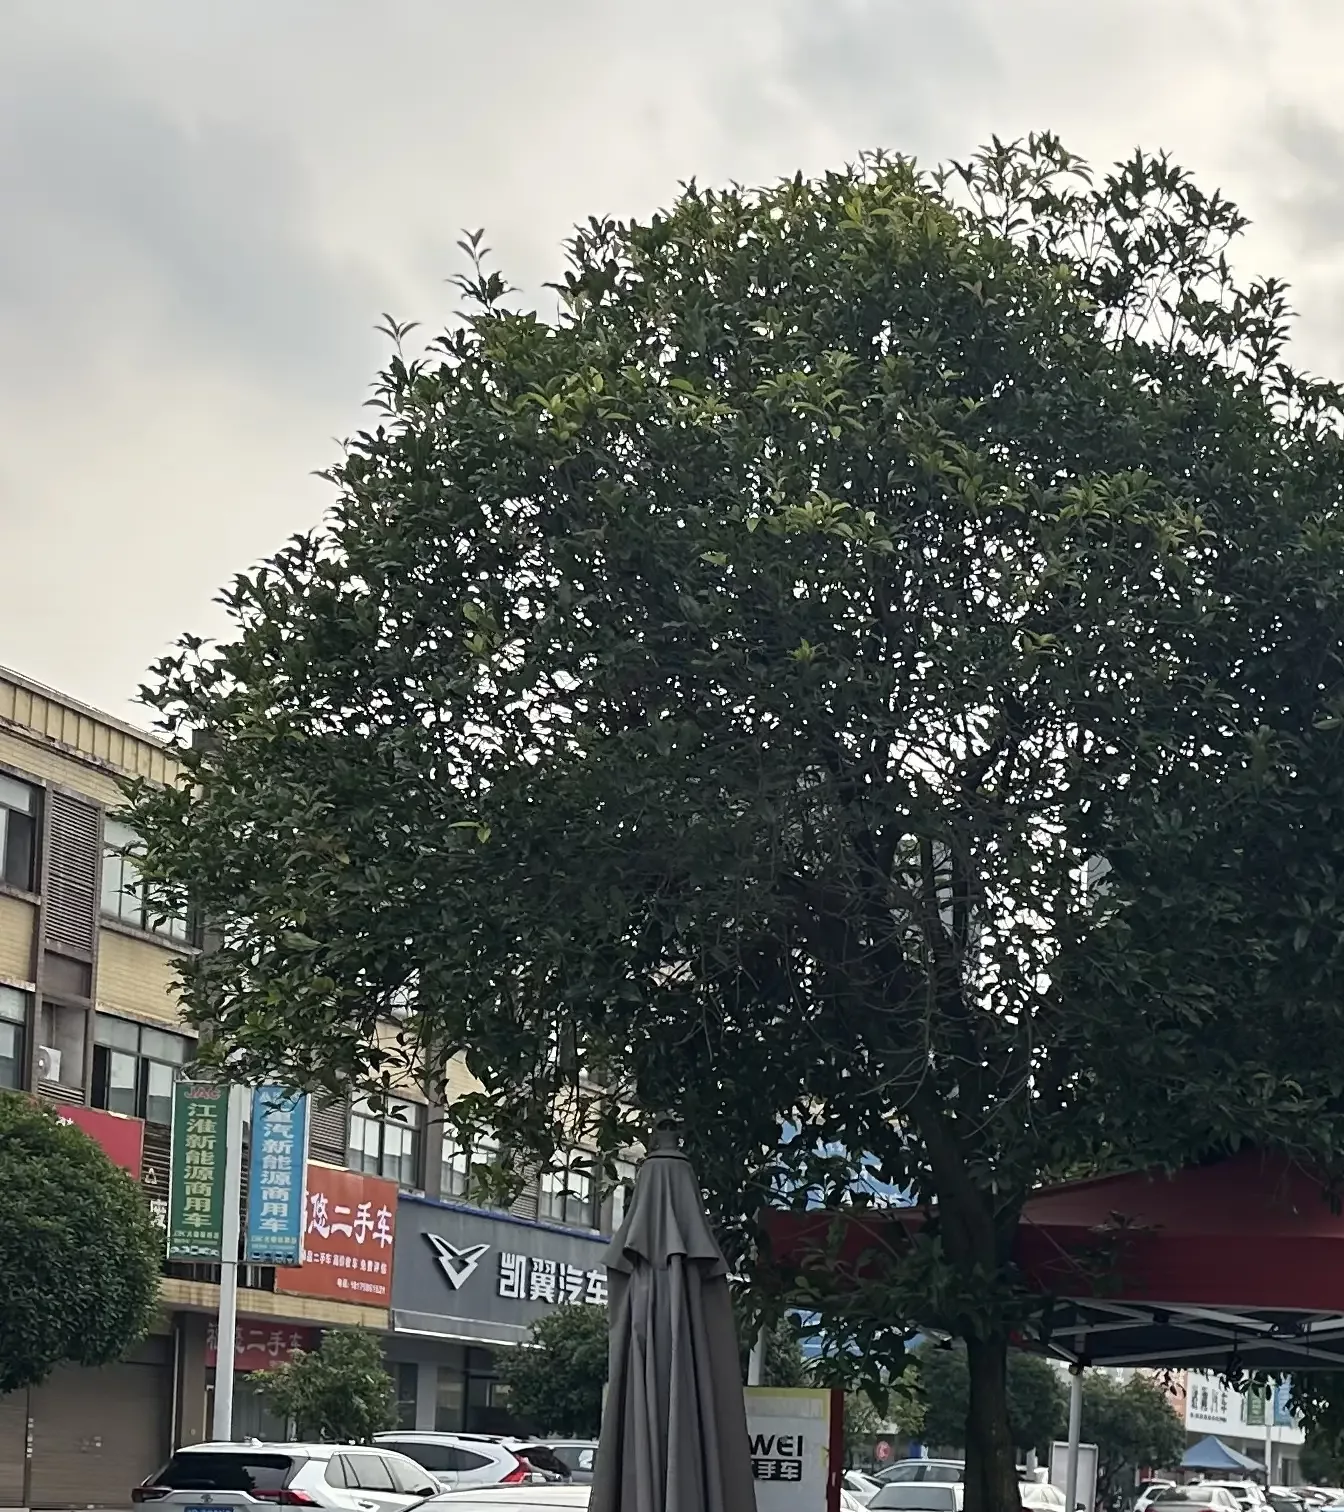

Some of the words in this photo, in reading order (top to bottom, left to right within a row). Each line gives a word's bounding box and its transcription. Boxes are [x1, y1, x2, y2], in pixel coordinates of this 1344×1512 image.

[184, 1086, 222, 1100] JAC
[181, 1102, 218, 1229] 江淮新能源商用车
[304, 1190, 394, 1249] 悠二手车
[499, 1251, 609, 1306] 凯翼汽车
[751, 1460, 800, 1480] 手车
